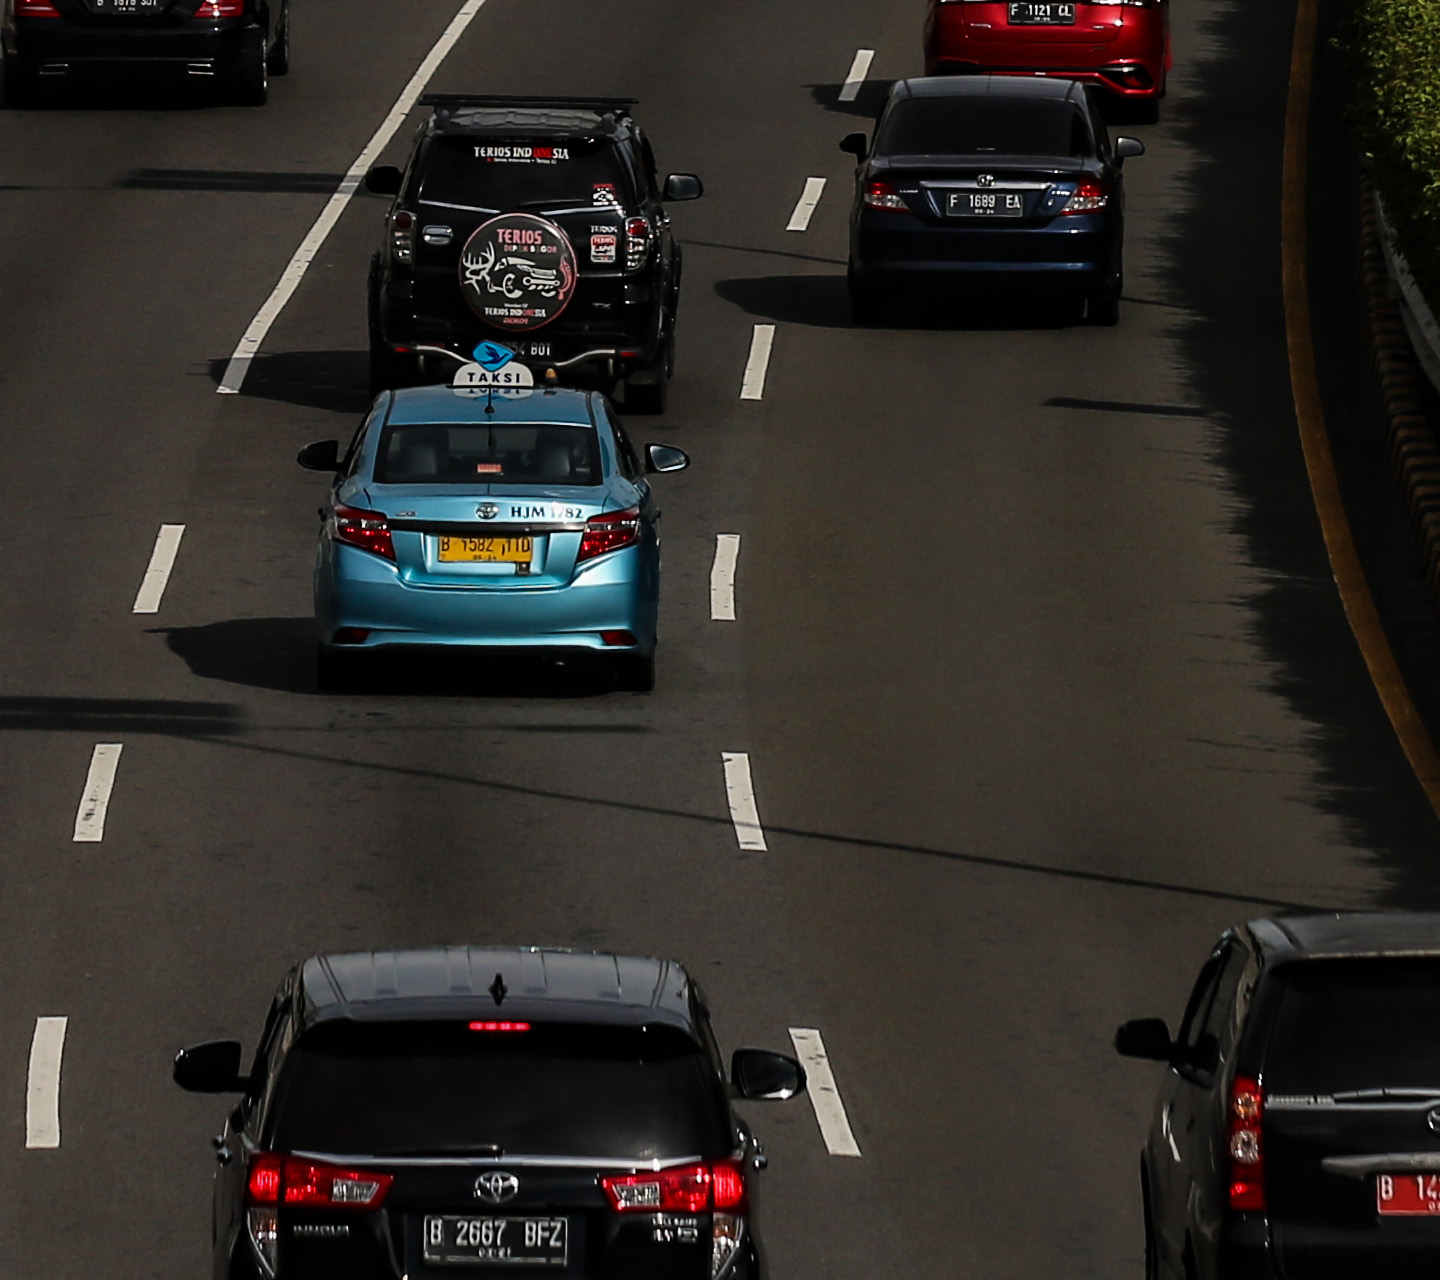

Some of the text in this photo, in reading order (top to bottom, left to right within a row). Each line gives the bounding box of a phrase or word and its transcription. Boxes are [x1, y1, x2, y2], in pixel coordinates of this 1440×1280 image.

[1011, 3, 1019, 17] F
[1028, 4, 1051, 17] 1121
[474, 146, 570, 160] TERIOS INDONESIA
[950, 194, 1021, 209] F 1689 EA
[497, 228, 543, 245] TERIOS
[468, 372, 520, 383] TAKSI
[511, 506, 545, 519] HJM
[441, 537, 450, 552] B
[1380, 1175, 1394, 1201] B
[430, 1219, 563, 1248] B 2667 BFZ
